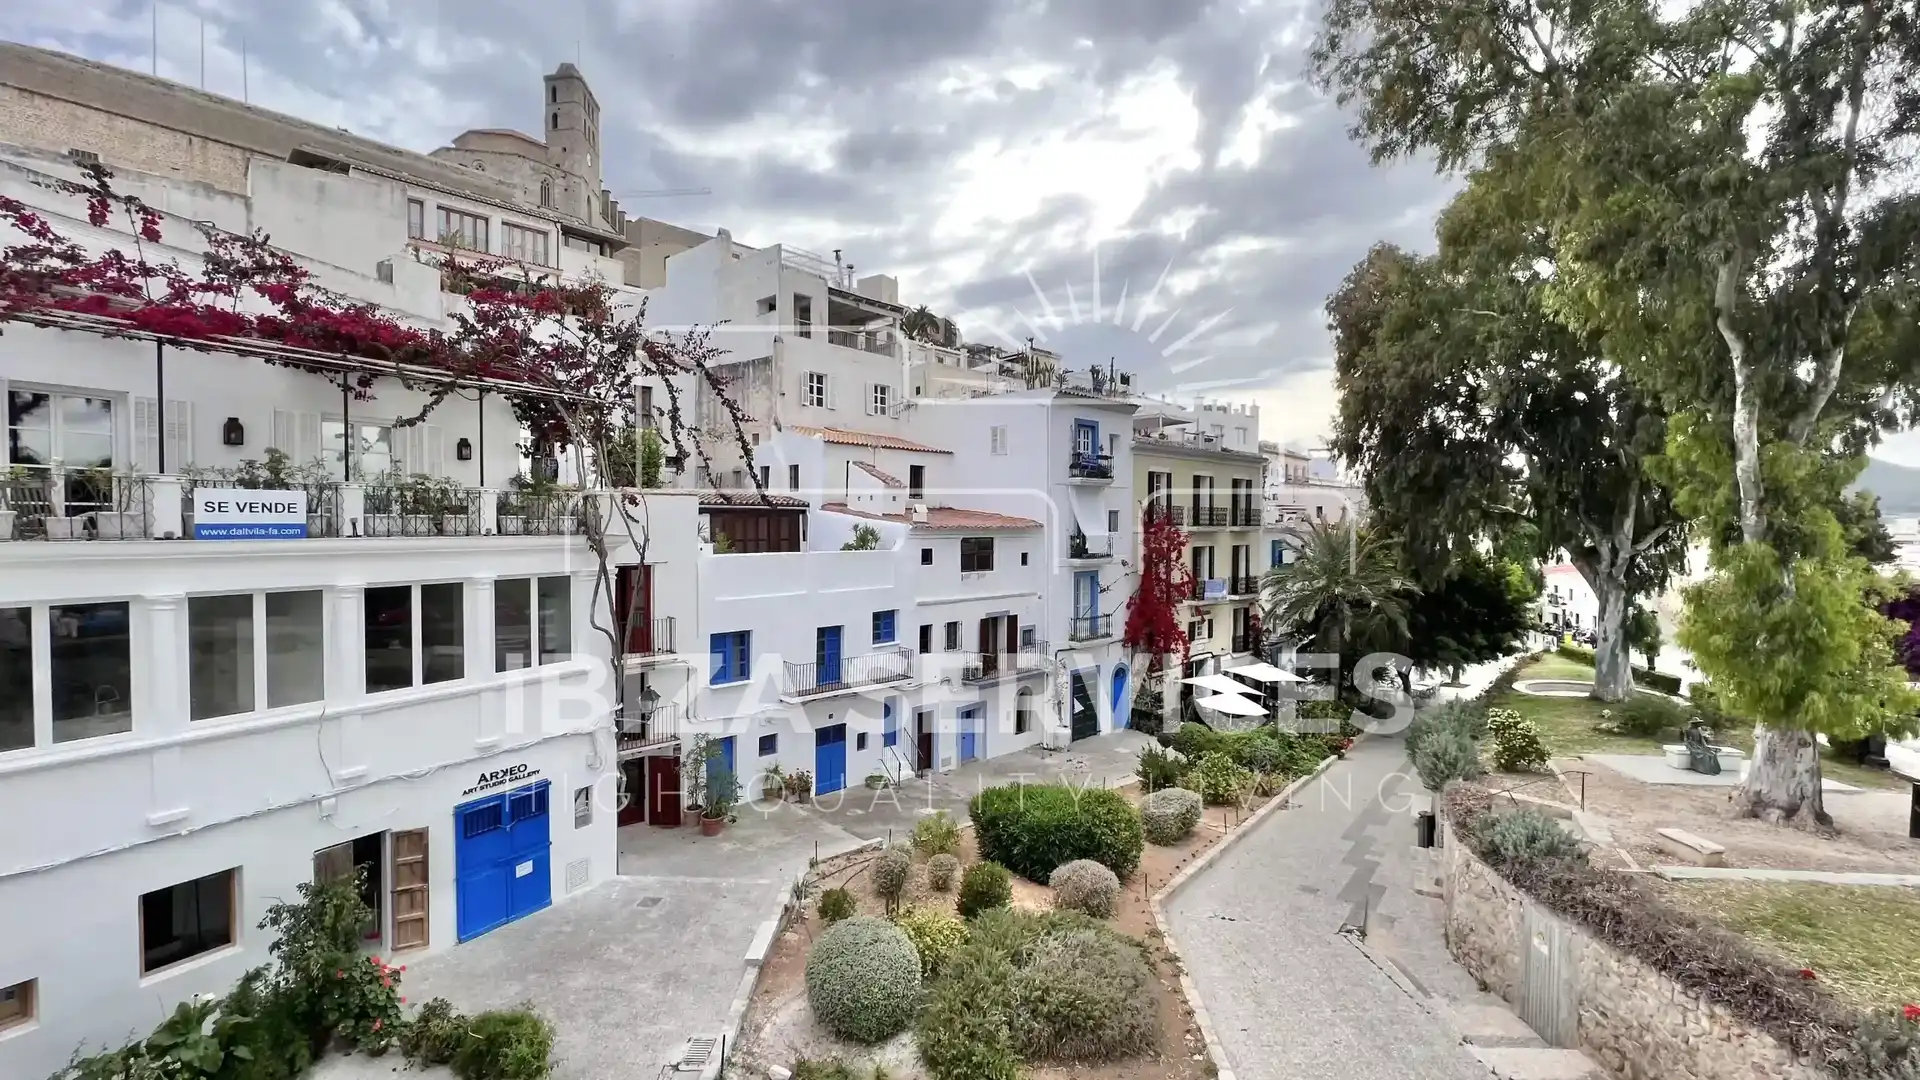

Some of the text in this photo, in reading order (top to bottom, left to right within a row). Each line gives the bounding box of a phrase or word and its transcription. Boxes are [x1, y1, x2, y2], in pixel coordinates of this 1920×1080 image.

[204, 501, 298, 514] SE VENDE
[462, 769, 541, 797] ART STUDIO GALLERY
